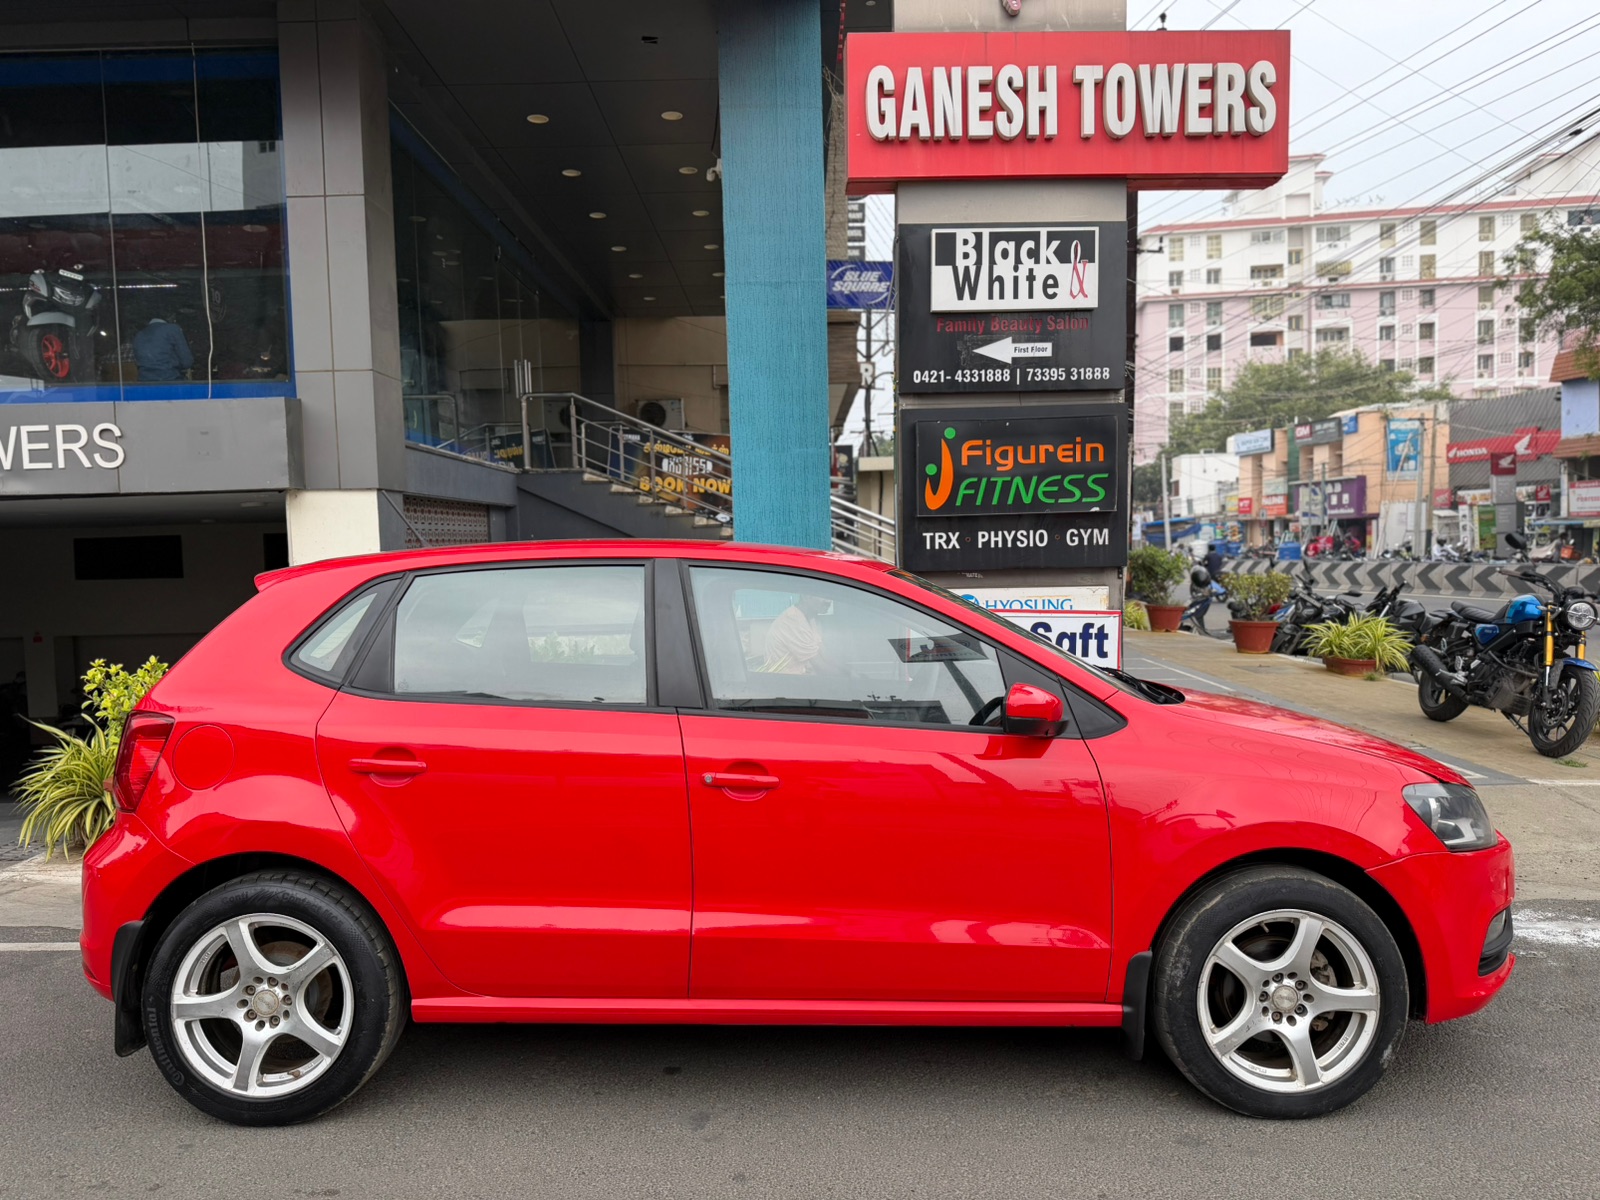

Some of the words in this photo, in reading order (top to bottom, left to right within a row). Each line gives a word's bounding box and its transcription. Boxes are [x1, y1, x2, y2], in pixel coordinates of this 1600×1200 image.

[865, 64, 1058, 142] GANESH
[1072, 60, 1278, 139] TOWERS
[955, 230, 1061, 266] Black
[842, 270, 881, 281] BLUE
[951, 264, 1060, 301] White
[832, 281, 890, 294] SQUARE
[936, 317, 985, 334] Family
[991, 316, 1043, 334] Beauty
[1047, 315, 1089, 331] Salon
[1013, 345, 1029, 354] First
[1031, 345, 1048, 353] Floor
[954, 368, 1011, 383] 4331888
[1026, 367, 1066, 382] 73395
[1070, 366, 1110, 380] 31888
[961, 436, 1105, 471] Figurein
[1456, 446, 1488, 458] HONDA
[693, 477, 732, 494] NOW
[955, 473, 1109, 506] FITNESS
[922, 531, 961, 550] TRX
[977, 529, 1048, 549] PHYSIO
[1065, 528, 1109, 546] GYM
[985, 598, 1073, 610] HYOSUNG
